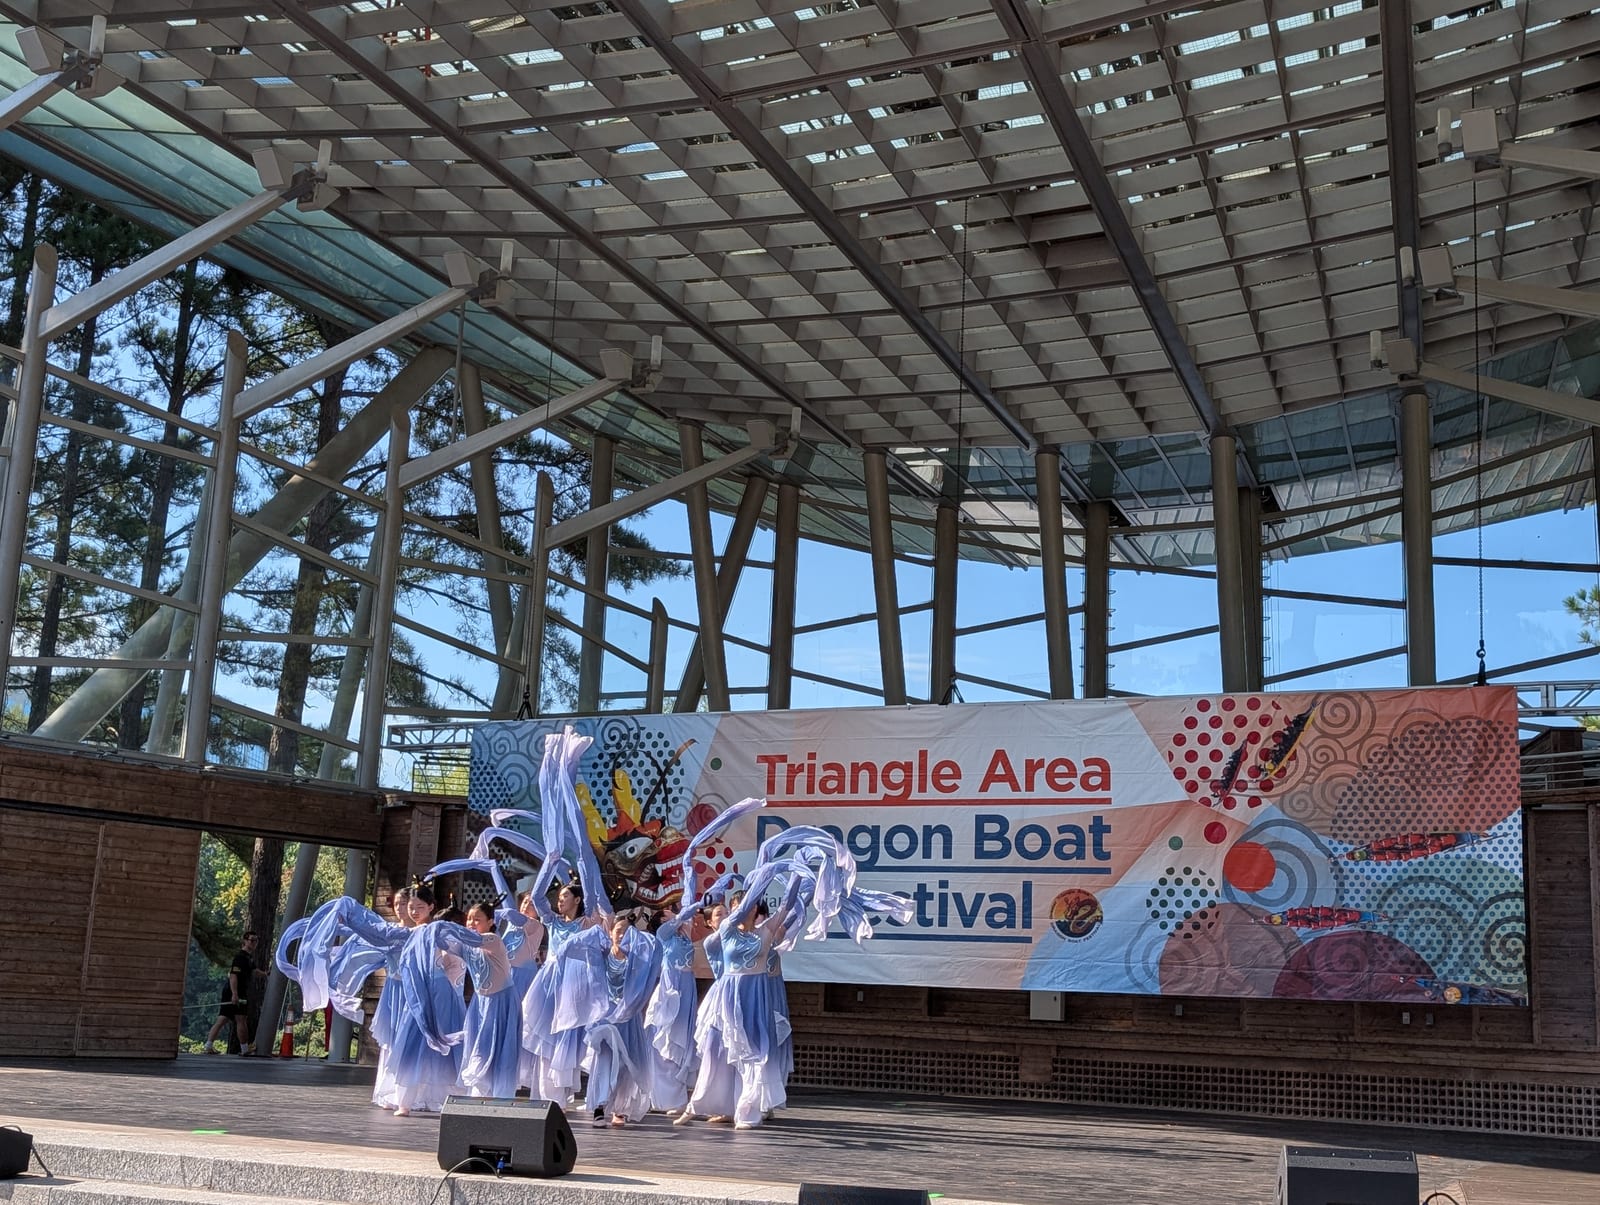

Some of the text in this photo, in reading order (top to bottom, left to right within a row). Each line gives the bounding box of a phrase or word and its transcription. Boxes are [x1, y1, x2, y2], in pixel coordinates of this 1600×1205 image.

[756, 748, 1111, 801] Triangle Area
[756, 814, 1111, 867] Dgon Boat
[850, 880, 1032, 930] tival
